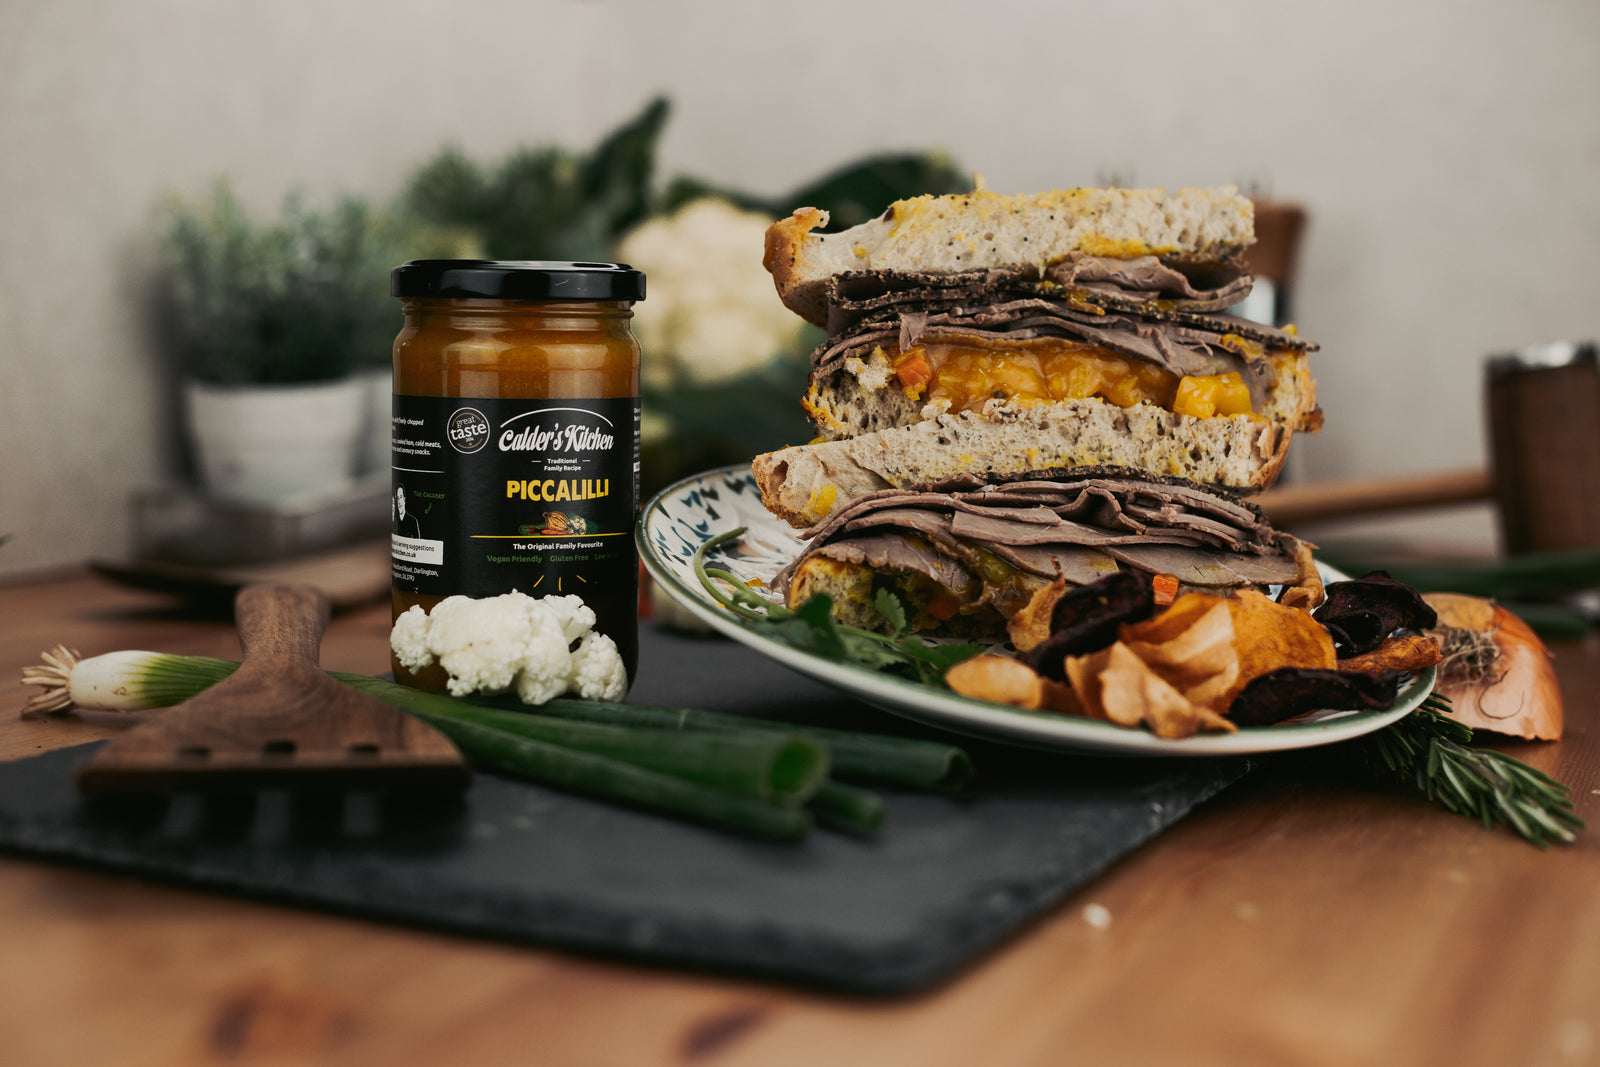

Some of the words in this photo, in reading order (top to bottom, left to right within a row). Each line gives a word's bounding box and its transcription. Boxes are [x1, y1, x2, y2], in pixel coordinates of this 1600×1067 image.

[407, 418, 424, 426] chopped
[456, 415, 476, 428] great
[450, 423, 487, 440] taste
[498, 423, 564, 452] Calder's
[564, 424, 614, 452] Kitchen
[425, 441, 442, 449] meats,
[506, 478, 609, 502] PICCALILLI
[527, 543, 555, 552] Original
[555, 542, 576, 551] Family
[577, 541, 604, 549] Favourite
[486, 555, 511, 564] Vegan
[511, 555, 543, 564] Friendly
[413, 567, 439, 577] Darlington,
